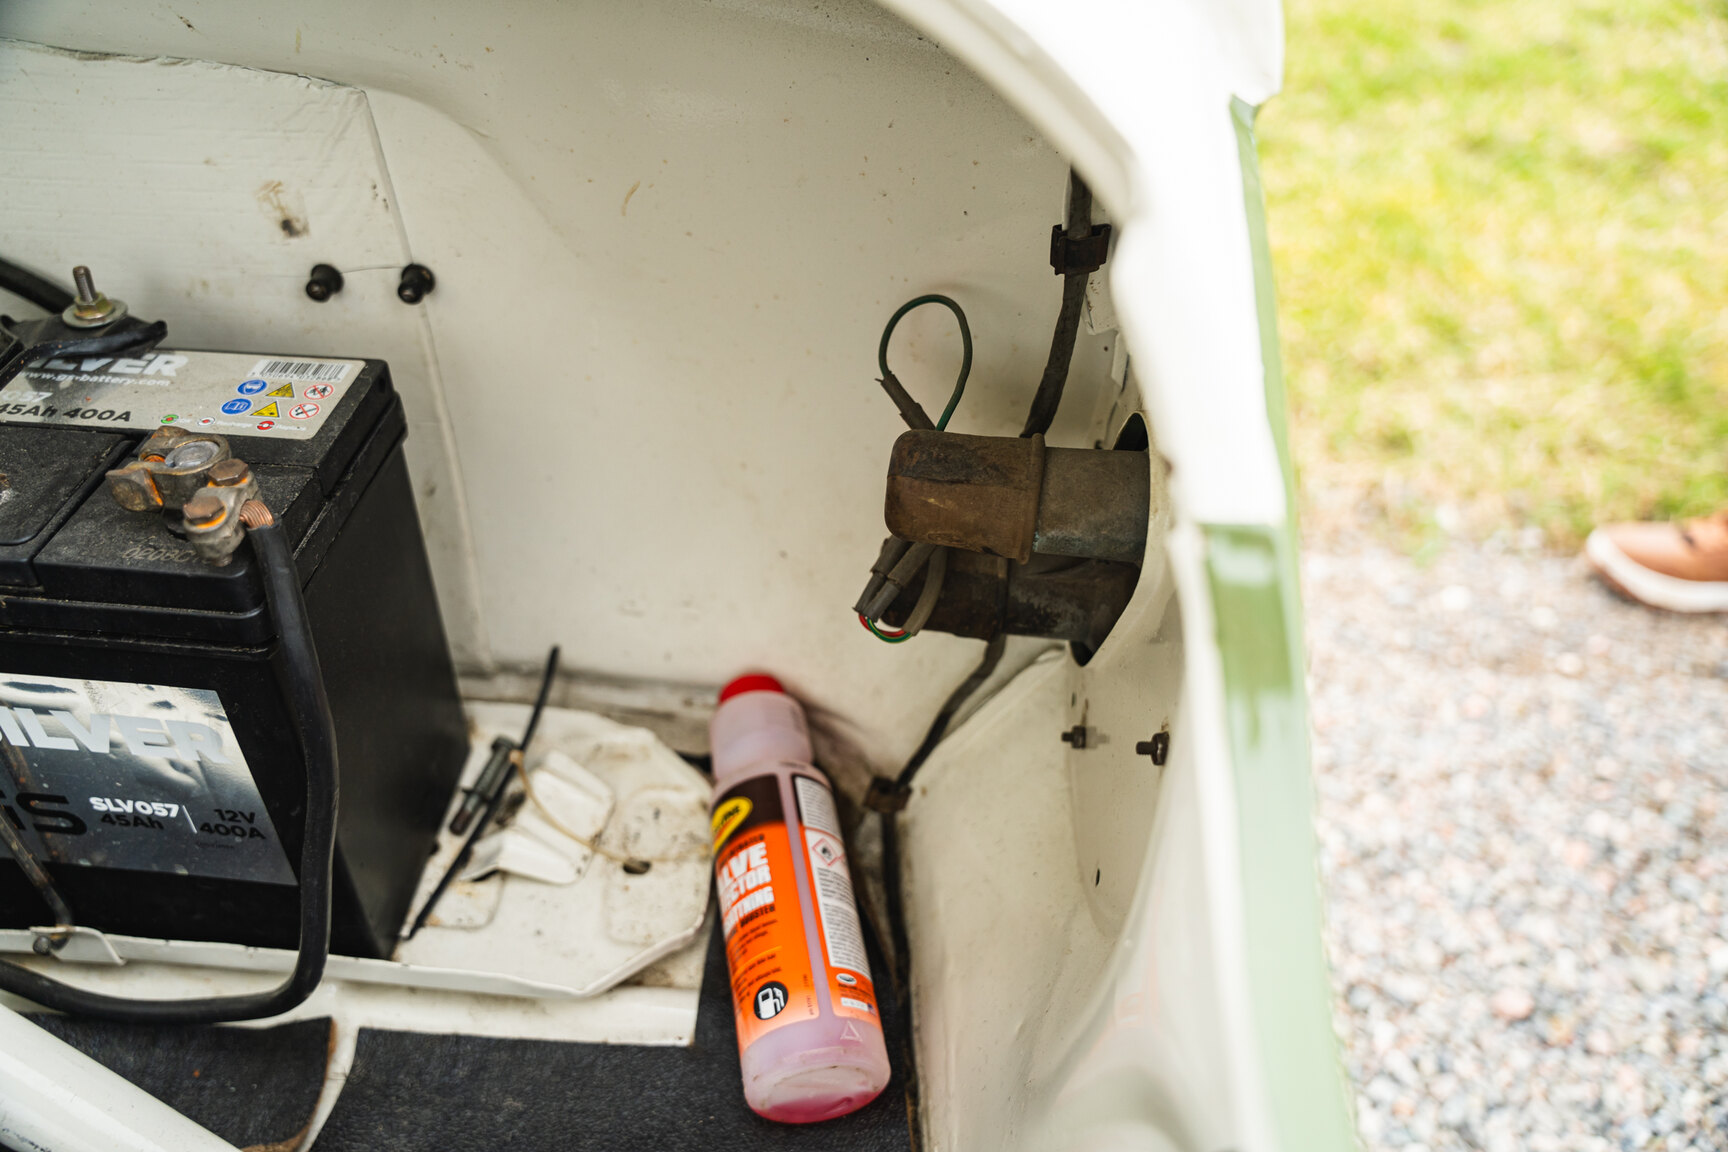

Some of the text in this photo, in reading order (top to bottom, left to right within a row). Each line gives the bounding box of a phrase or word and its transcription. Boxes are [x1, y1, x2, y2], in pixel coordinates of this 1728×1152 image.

[28, 353, 189, 377] ILVER
[63, 407, 132, 422] 400A
[0, 706, 233, 765] ILVER
[89, 796, 180, 818] SLV057
[100, 812, 165, 830] 45Ah
[214, 809, 256, 824] 12V
[200, 822, 266, 839] 400A
